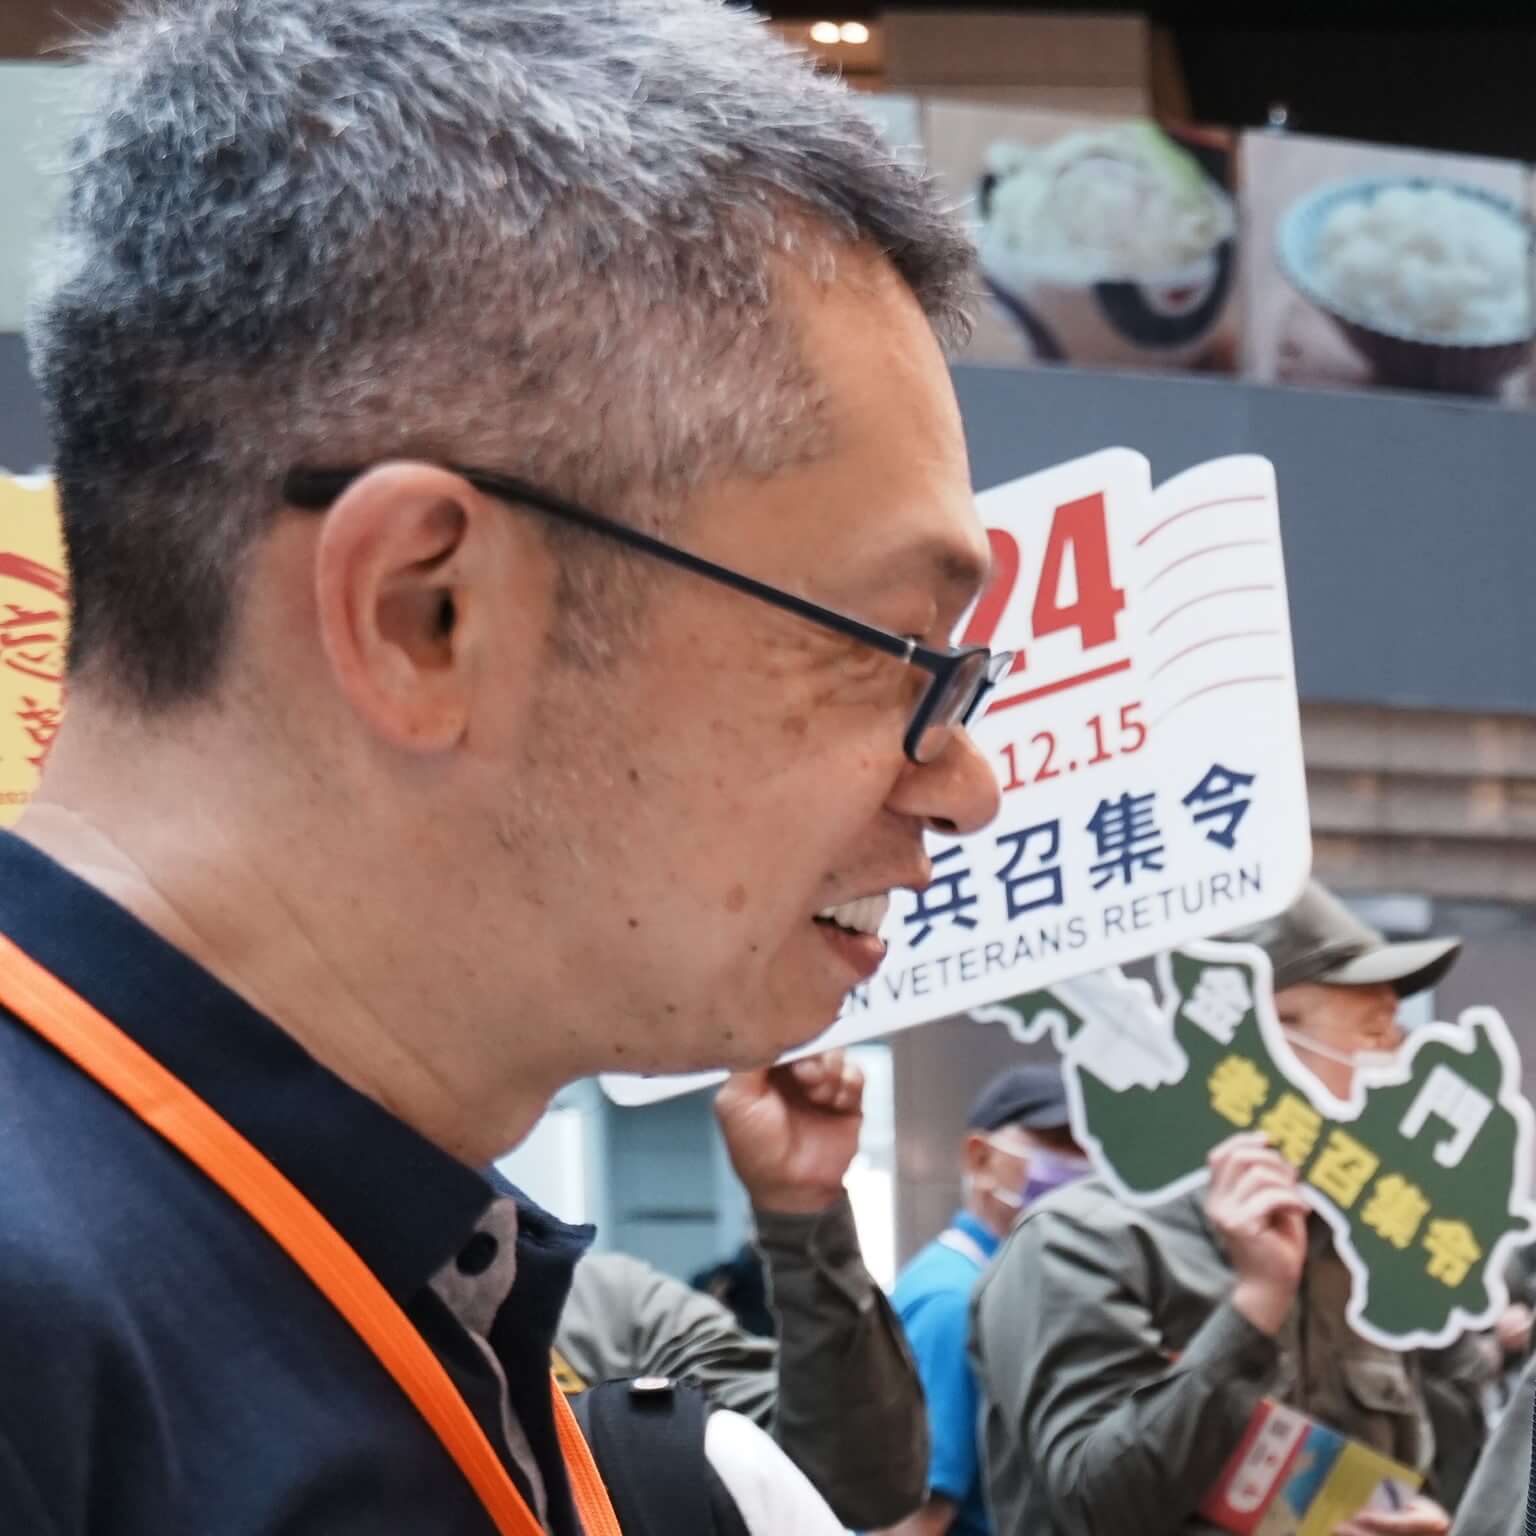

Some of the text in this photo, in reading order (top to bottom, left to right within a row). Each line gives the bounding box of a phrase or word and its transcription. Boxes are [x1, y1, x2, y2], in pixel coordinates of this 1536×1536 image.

[1000, 701, 1148, 793] 12.15
[904, 762, 1258, 948] 兵召集令
[885, 862, 1265, 1003] VETERANS RETURN
